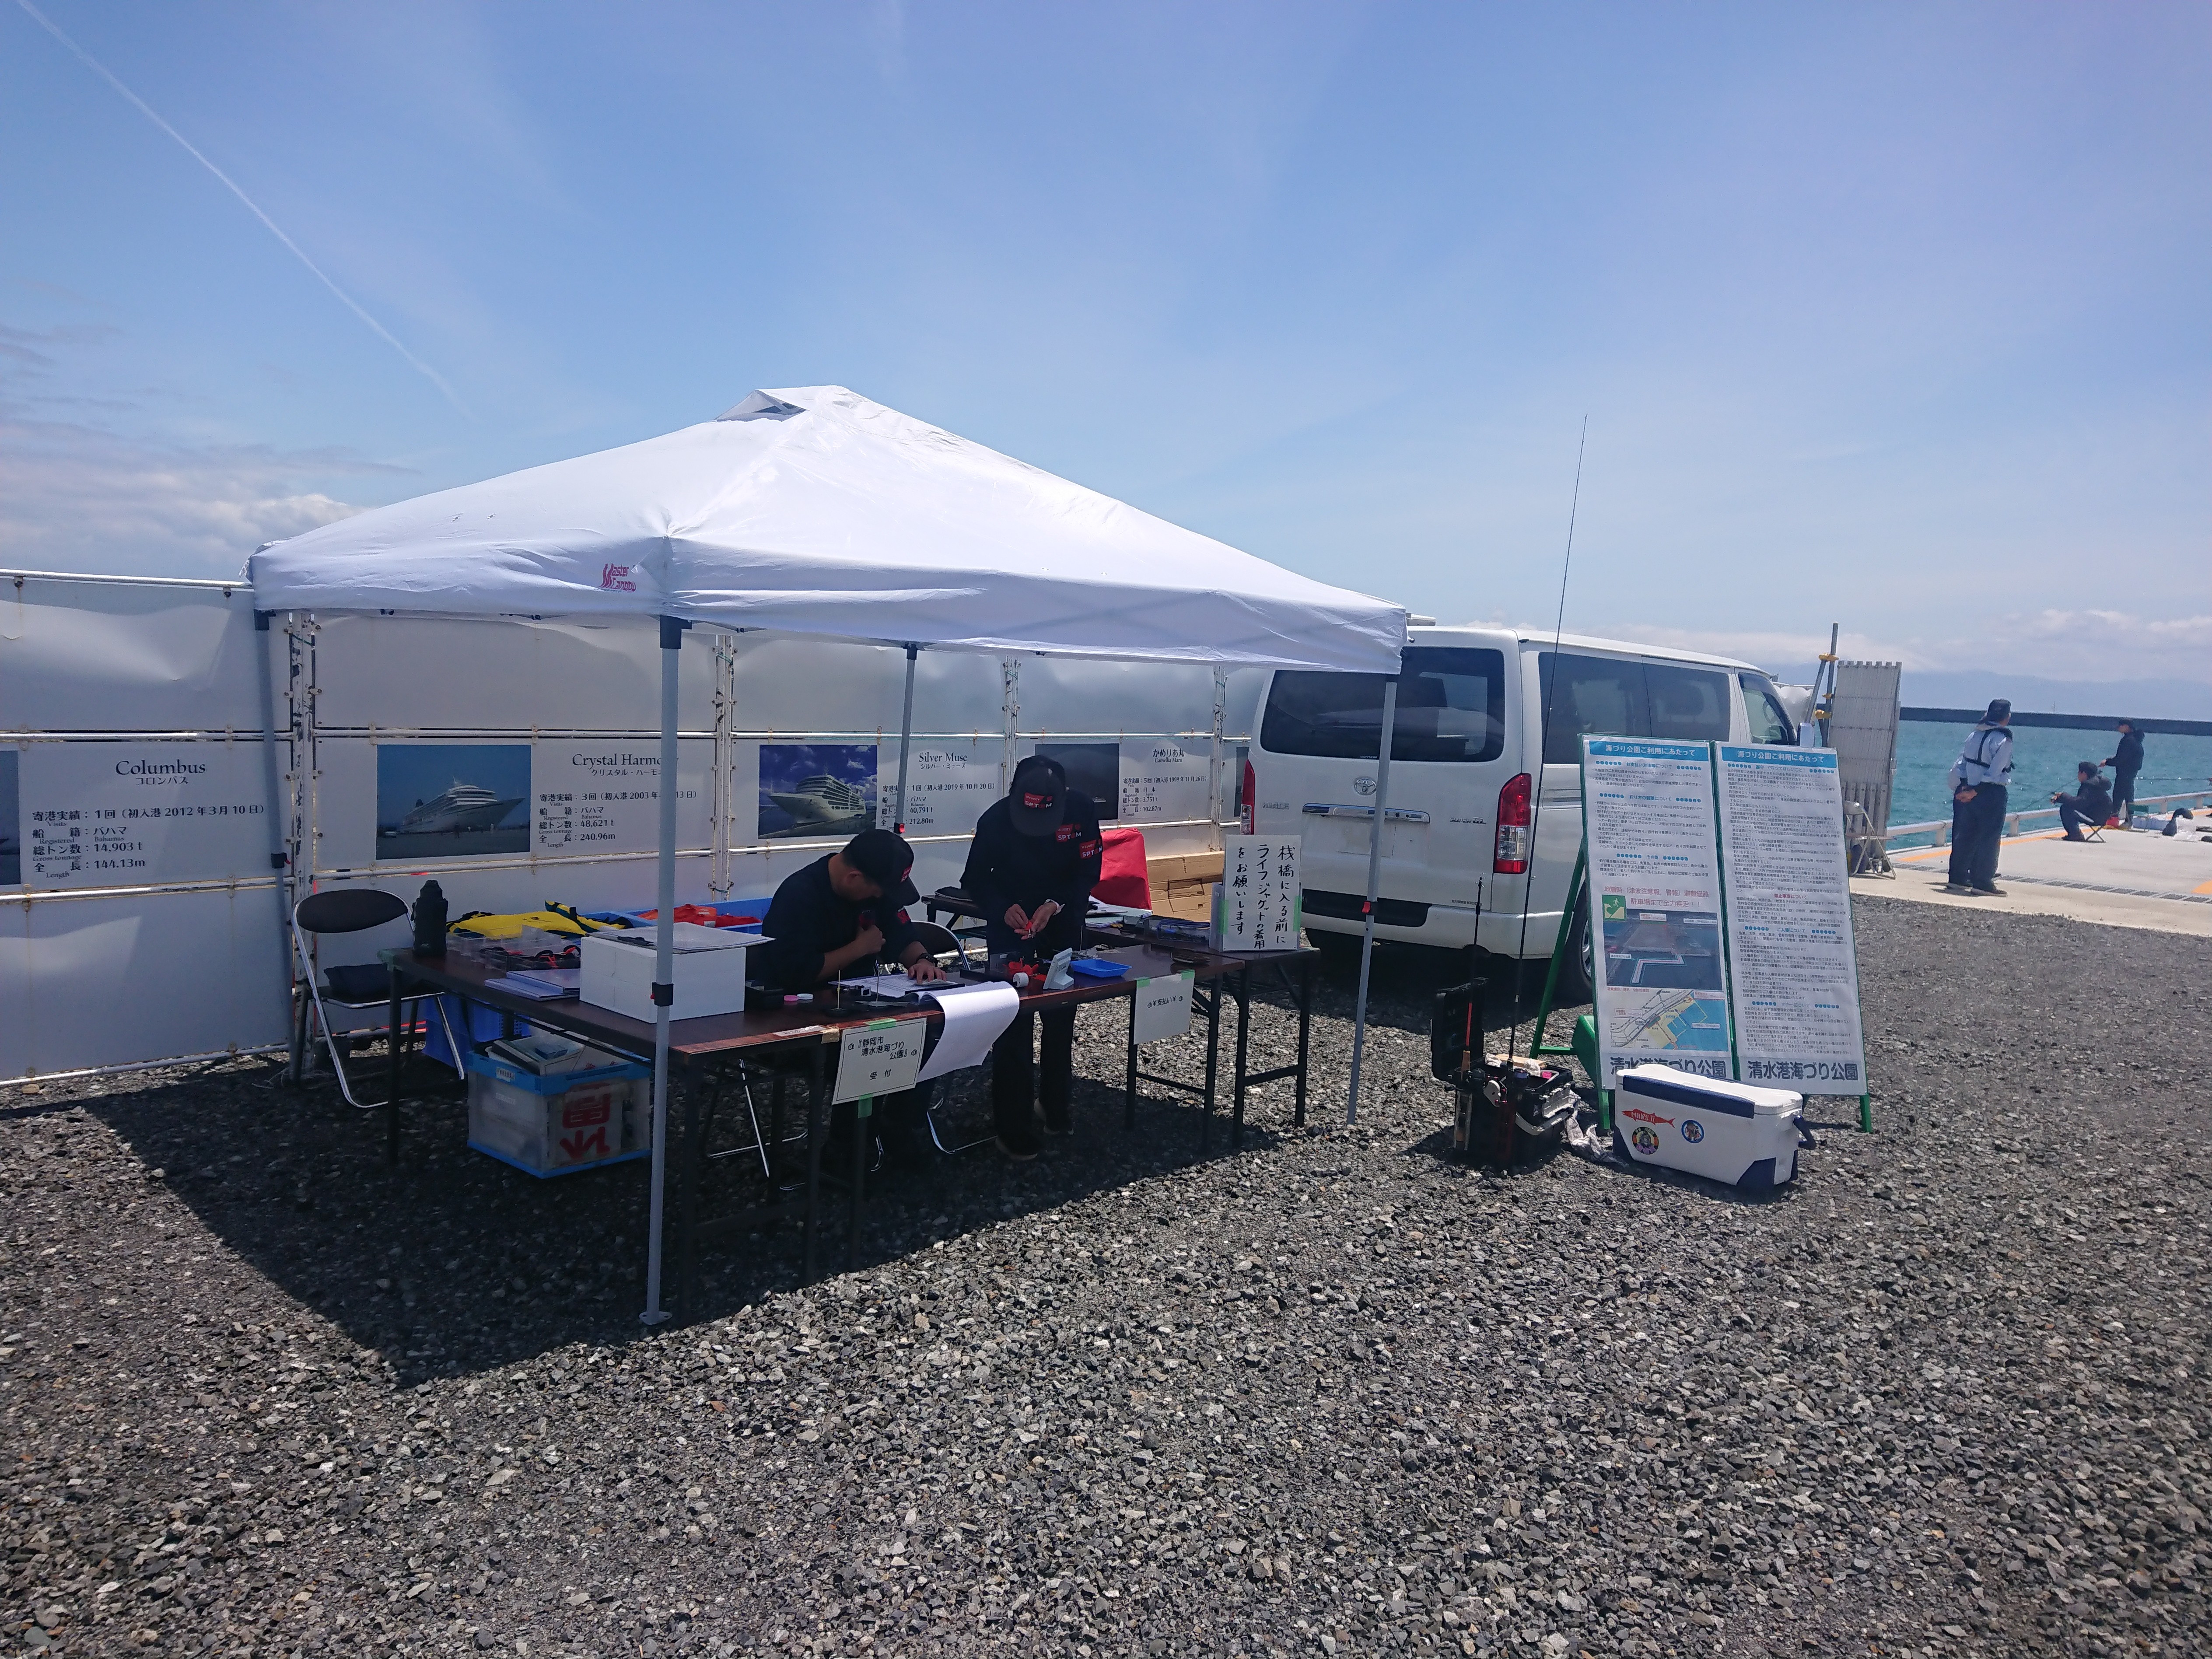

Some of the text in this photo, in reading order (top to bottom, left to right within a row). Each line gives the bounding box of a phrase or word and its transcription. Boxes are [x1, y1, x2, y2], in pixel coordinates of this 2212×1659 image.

[919, 752, 967, 762] Silver Muse
[1153, 748, 1184, 757] かめりあ丸
[1605, 744, 1696, 756] 海づり公園ご利用にあたって
[1738, 750, 1824, 763] 海づり公園ご利用にあたって
[116, 759, 206, 775] Columbus
[572, 753, 617, 770] Crystal
[136, 776, 188, 785] コロンバス
[1231, 847, 1248, 935] をお願いします
[1254, 844, 1270, 949] ライフジャケットの着用
[1275, 845, 1295, 944] 桟橋に入る前に
[861, 1041, 904, 1057] 清水港海づり
[889, 1049, 907, 1060] 公園』
[1748, 1060, 1858, 1081] 清水港海づり公園
